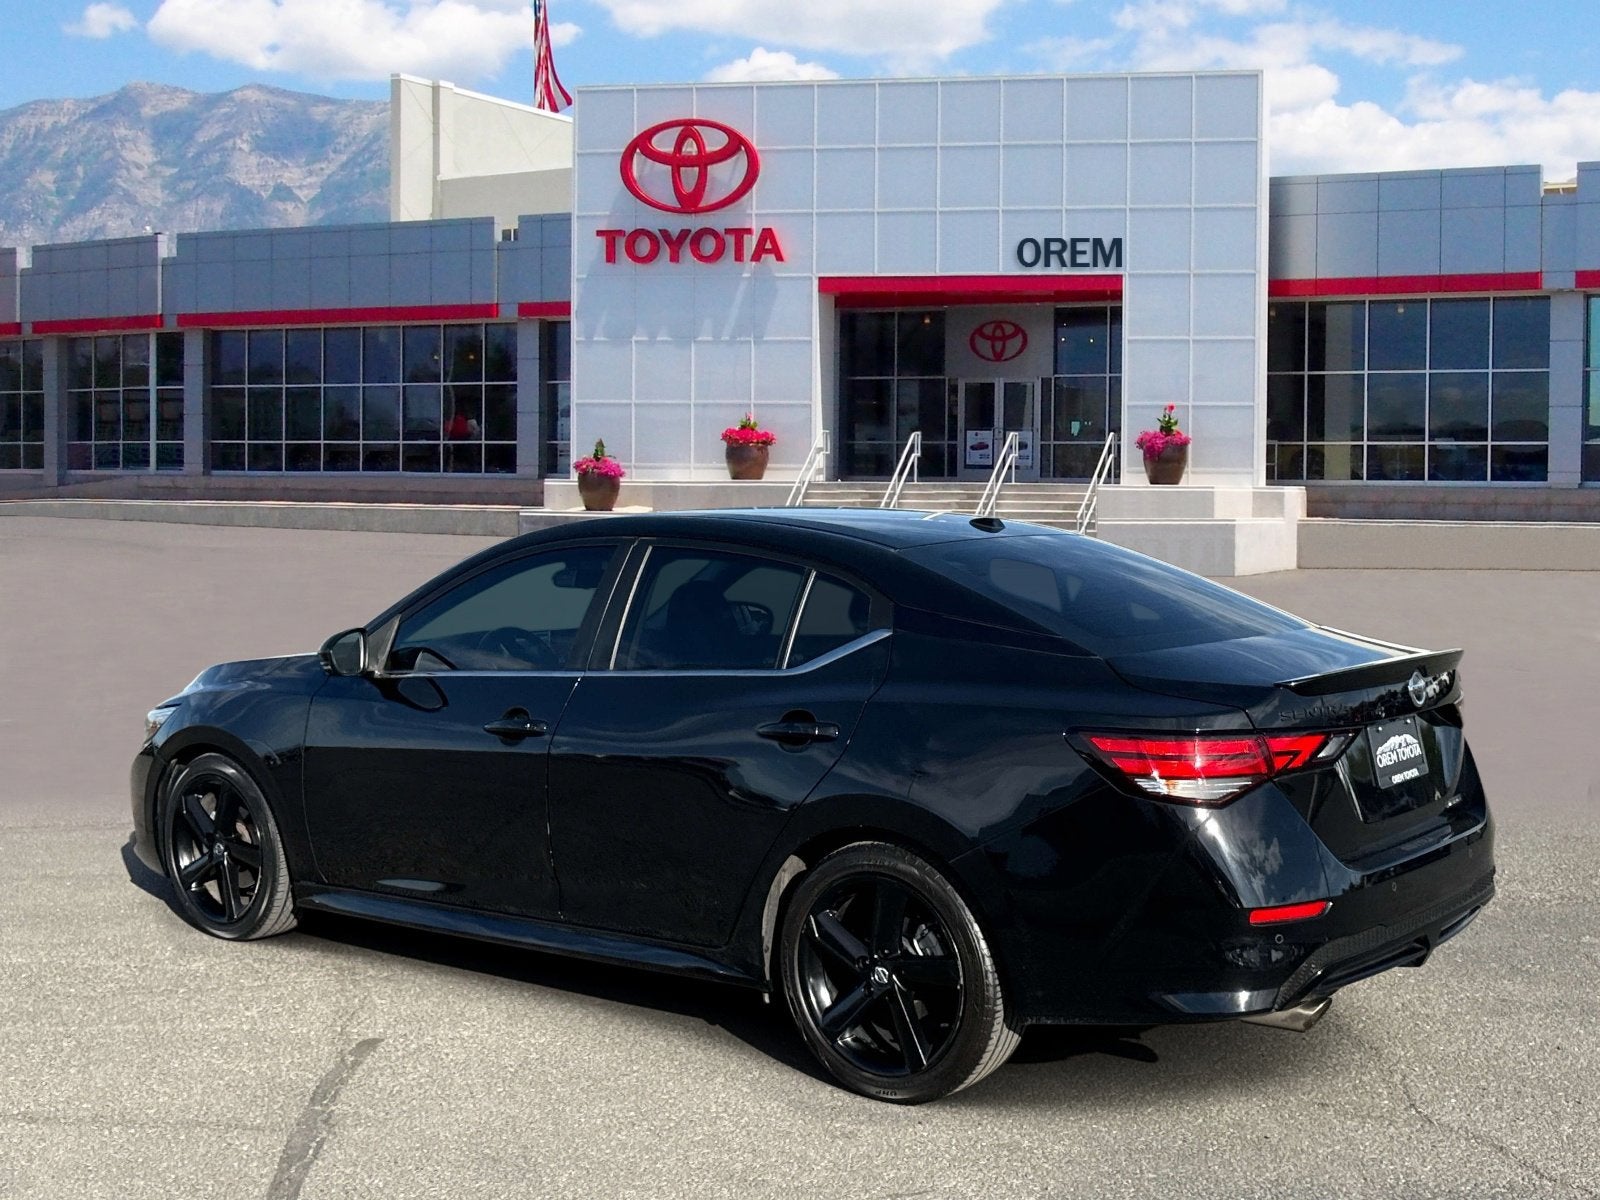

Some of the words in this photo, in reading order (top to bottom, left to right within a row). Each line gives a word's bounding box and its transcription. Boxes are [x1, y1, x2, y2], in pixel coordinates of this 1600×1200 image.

[596, 227, 784, 264] TOYOTA
[1017, 238, 1122, 267] OREM
[1377, 750, 1398, 767] OREM
[1397, 743, 1421, 761] TOYOTA
